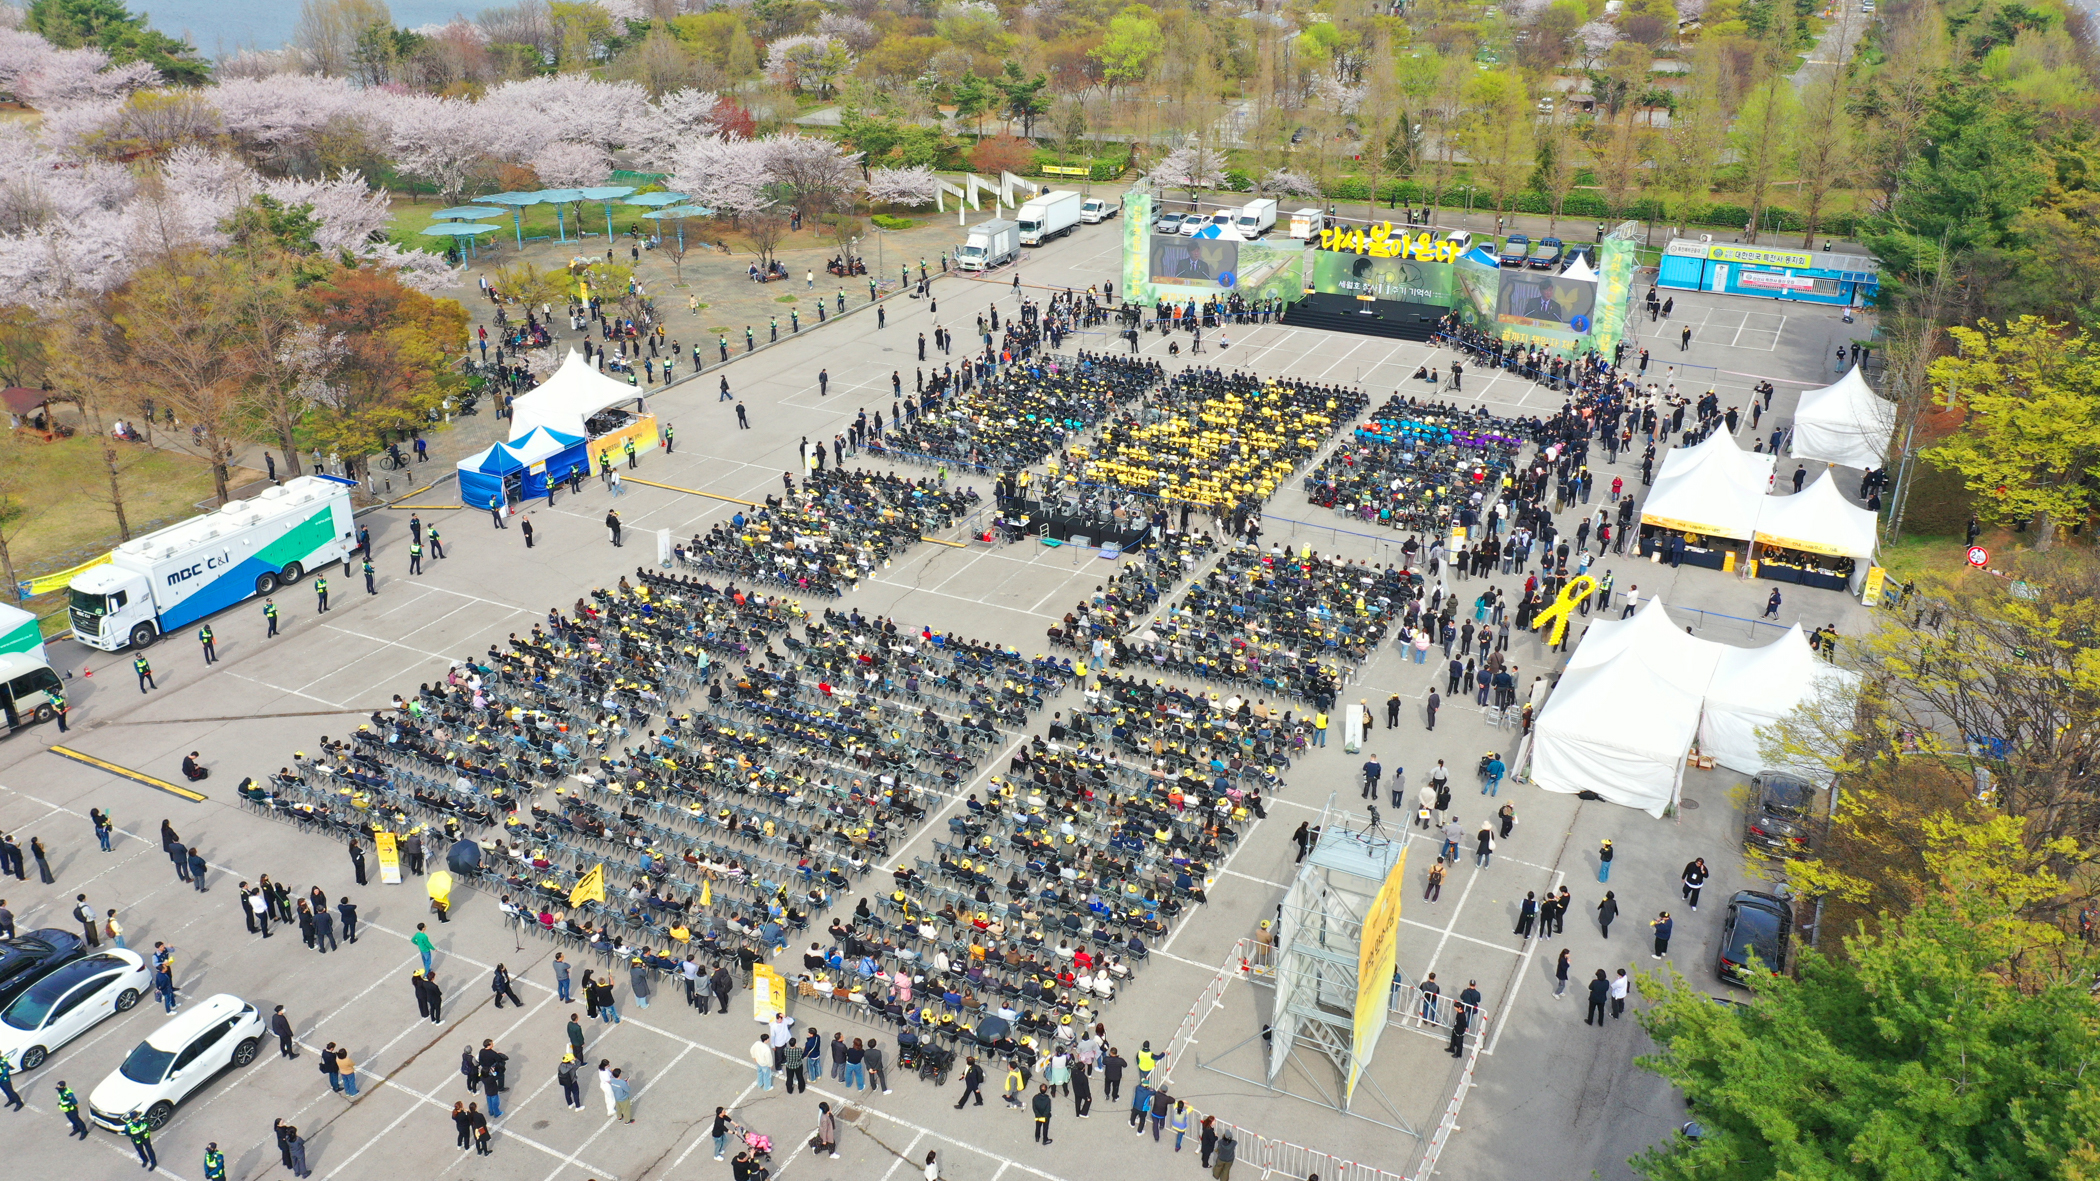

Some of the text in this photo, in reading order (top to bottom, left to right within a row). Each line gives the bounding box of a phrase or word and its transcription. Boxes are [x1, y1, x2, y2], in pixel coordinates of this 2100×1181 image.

[1319, 220, 1461, 264] 다시 봄이 온다
[1735, 251, 1805, 265] 대한민국 특전사 동지회
[1338, 280, 1360, 290] 세월호
[1409, 287, 1432, 298] 기억식
[1502, 330, 1529, 344] 끝까지
[1531, 334, 1559, 348] 책임자
[167, 552, 230, 586] MBC C&I
